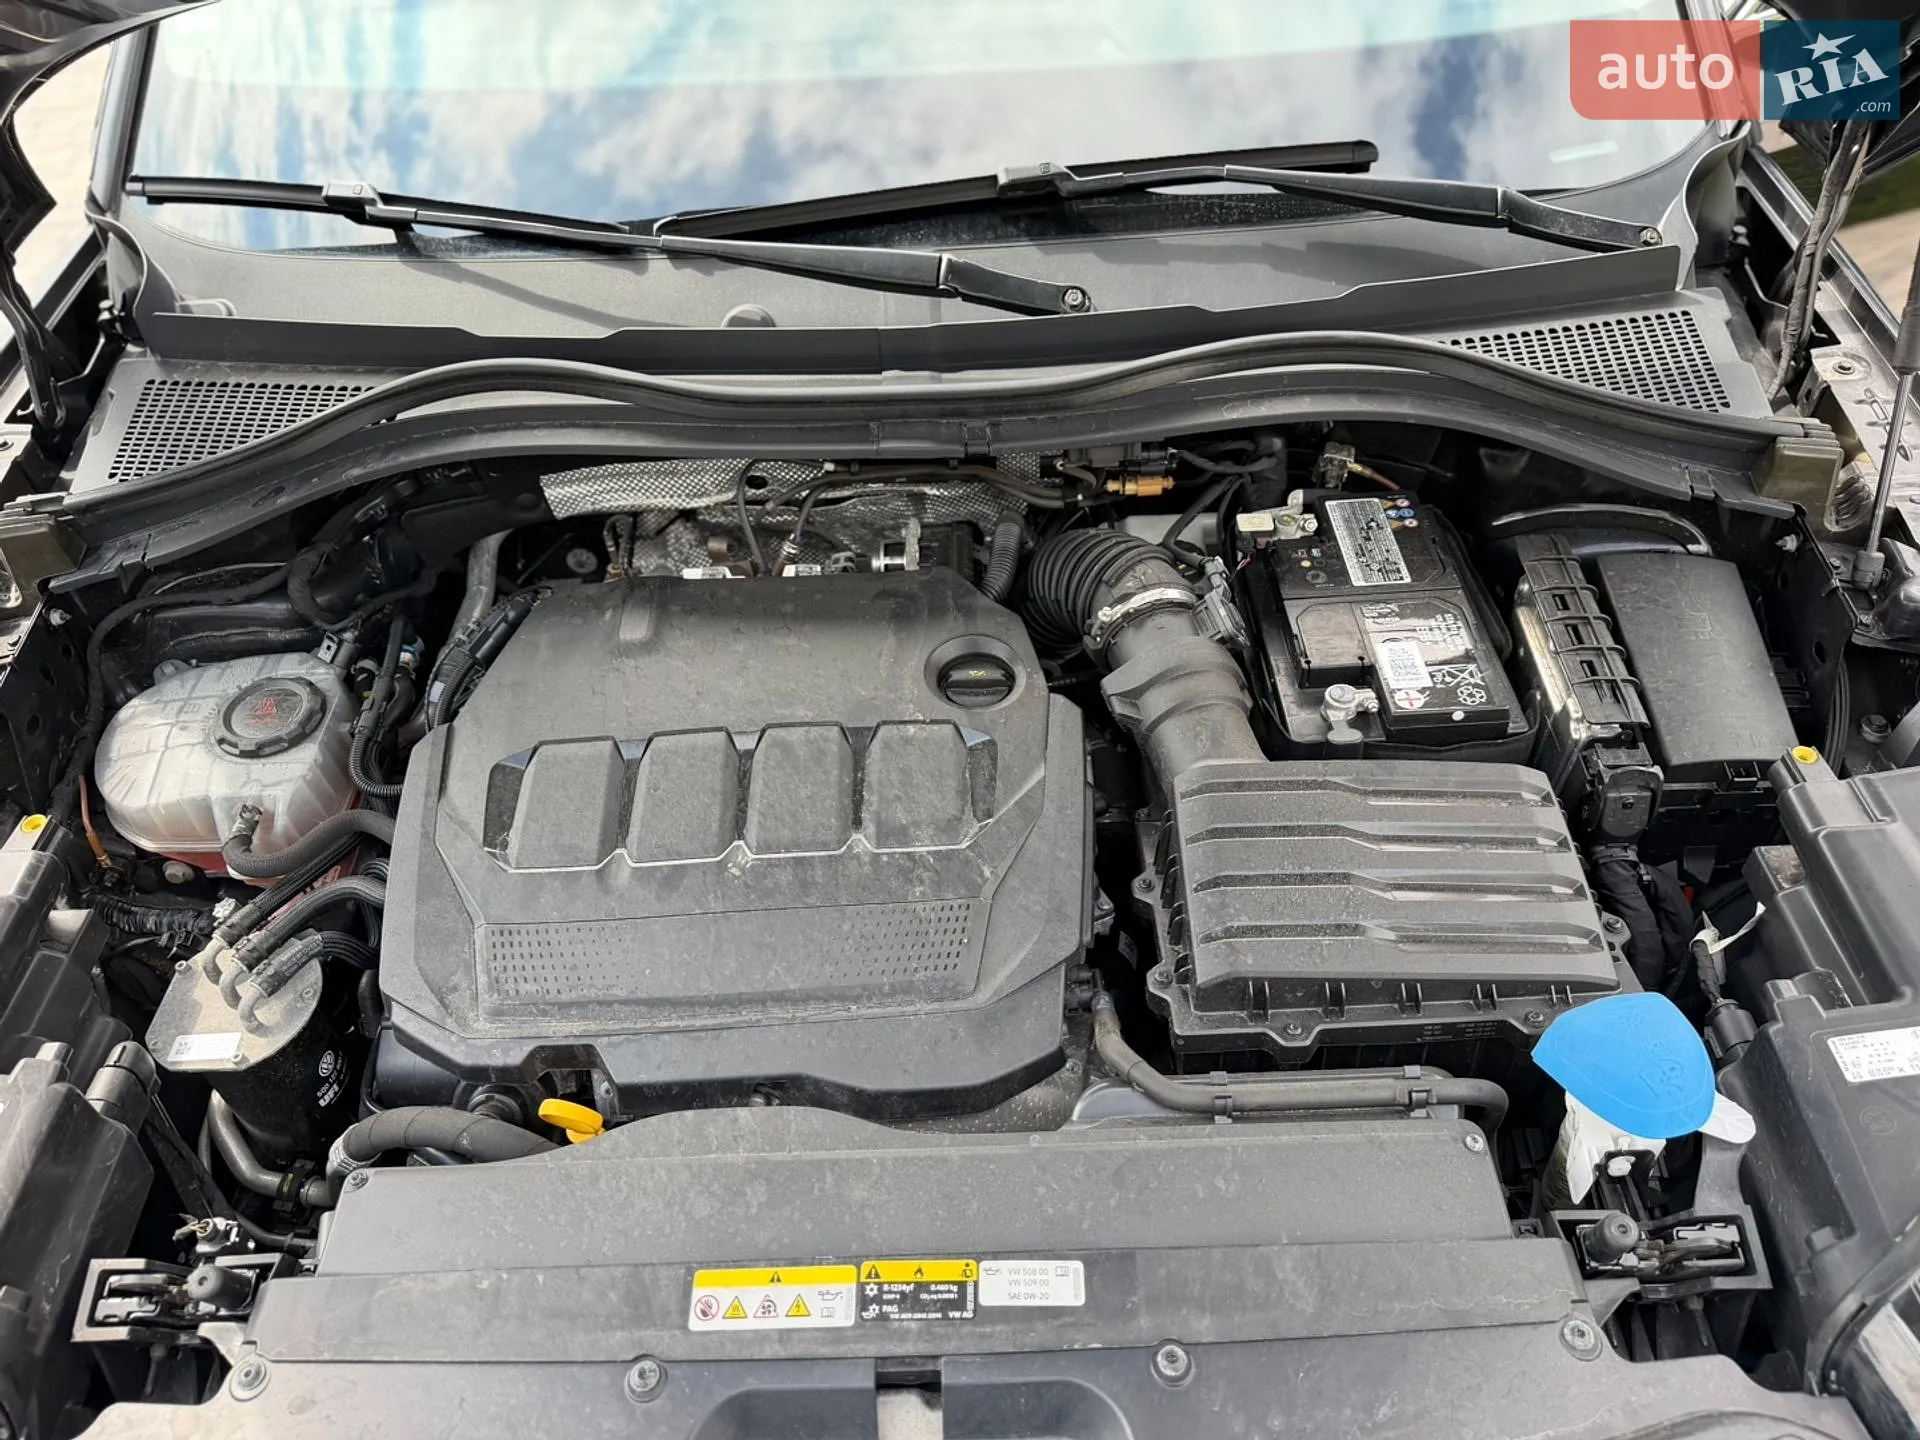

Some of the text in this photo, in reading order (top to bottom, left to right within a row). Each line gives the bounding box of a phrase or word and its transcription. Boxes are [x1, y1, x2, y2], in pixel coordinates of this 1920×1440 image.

[1007, 1267, 1049, 1276] VW 508 00
[1007, 1278, 1050, 1287] VW 509 00
[1007, 1291, 1022, 1300] SAE
[948, 1311, 961, 1319] VW
